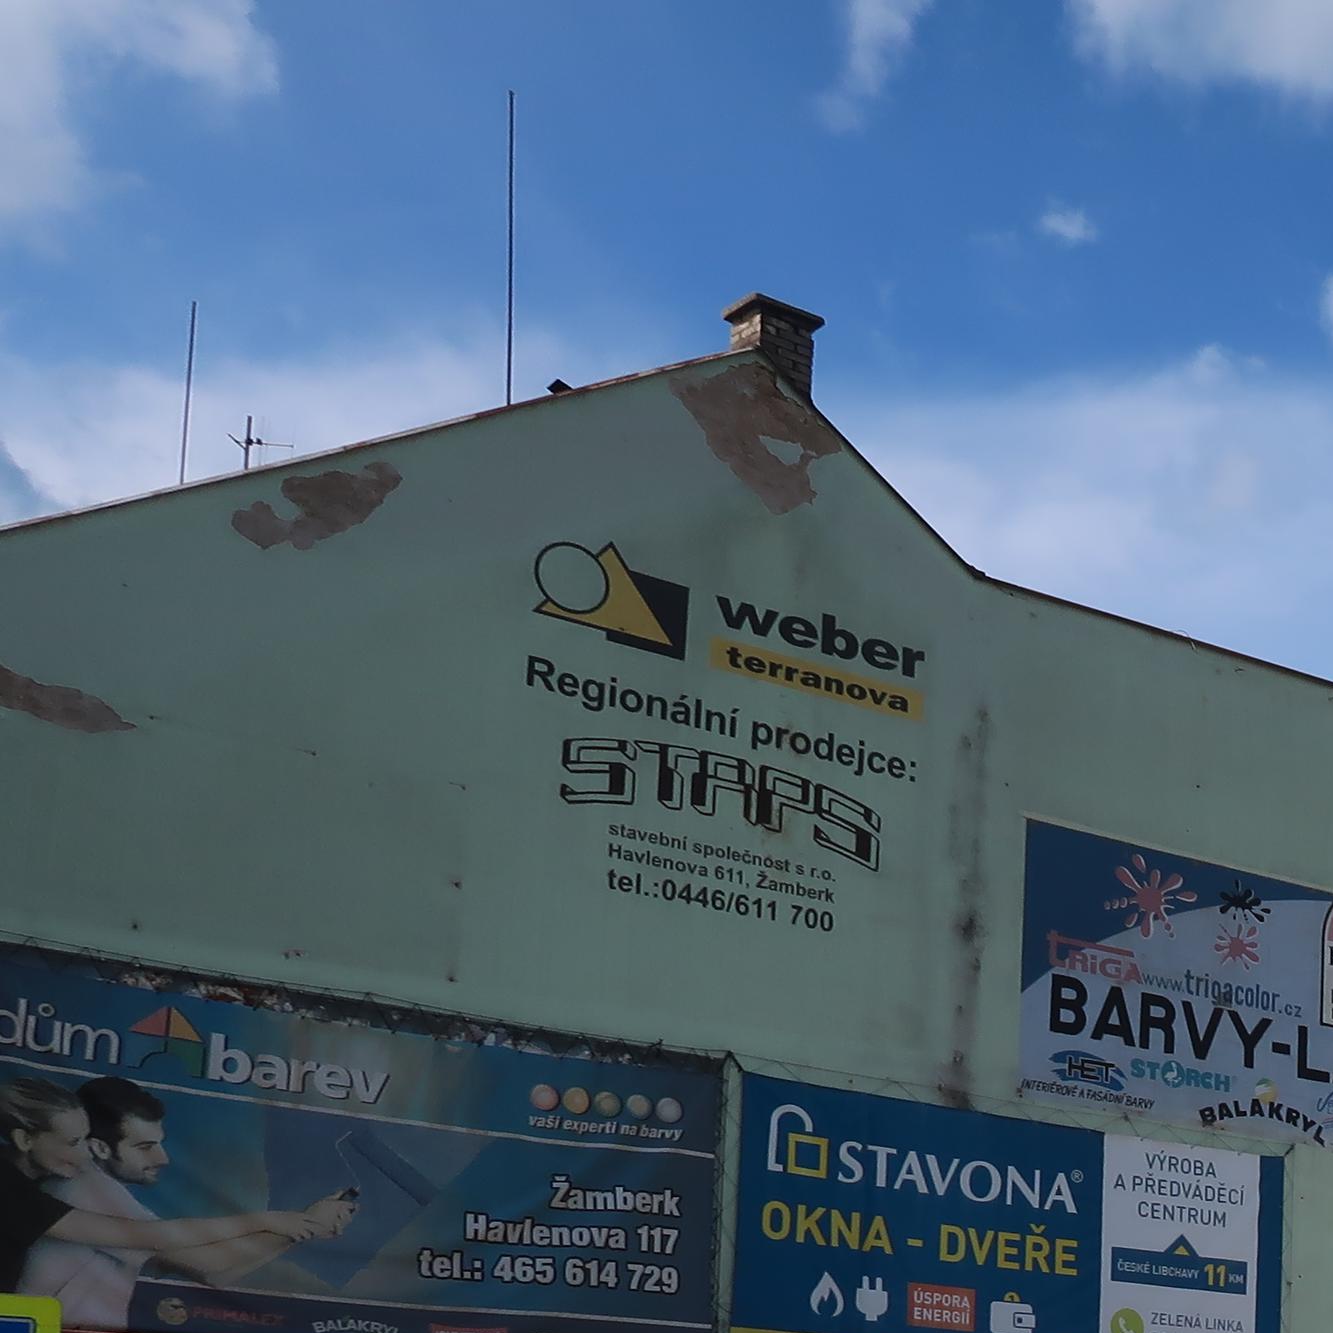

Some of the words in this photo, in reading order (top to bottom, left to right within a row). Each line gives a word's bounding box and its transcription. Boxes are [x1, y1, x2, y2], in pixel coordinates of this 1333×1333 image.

[715, 595, 926, 679] weber
[725, 645, 911, 714] terranova
[525, 655, 740, 738] Regionální
[750, 717, 918, 783] prodejce:
[560, 737, 881, 873] STAPS
[608, 823, 688, 852] stavební
[693, 839, 790, 876] společnost
[810, 863, 837, 882] r.o.
[608, 844, 708, 878] Havlenova
[715, 865, 750, 889] 611,
[755, 871, 836, 904] Žamberk
[790, 904, 834, 932] 700
[1141, 968, 1303, 1019] www.trigacolor.cz
[206, 1033, 391, 1104] barev
[1066, 1056, 1115, 1083] HET
[1021, 1078, 1078, 1097] INTERIÉROVÉ
[1125, 1096, 1155, 1110] BARVY
[529, 1113, 559, 1131] vaši
[563, 1117, 616, 1138] experti
[620, 1123, 636, 1137] na
[638, 1123, 682, 1142] barvy
[1144, 1150, 1216, 1179] VÝROBA
[549, 1174, 681, 1217] Žamberk
[1113, 1174, 1127, 1191] A
[1131, 1173, 1246, 1208] PŘEDVÁDĚCÍ
[464, 1211, 628, 1252] Havlenova
[636, 1226, 679, 1255] 117
[1137, 1199, 1228, 1228] CENTRUM
[762, 1200, 893, 1256] OKNA
[939, 1222, 1079, 1276] DVEŘE
[417, 1248, 484, 1282] tel.:
[494, 1255, 554, 1287] 465
[563, 1259, 617, 1290] 614
[627, 1264, 679, 1294] 729
[1117, 1257, 1149, 1275] ČESKÉ
[1151, 1264, 1199, 1281] LIBCHAVY
[1203, 1264, 1227, 1288] 11
[1228, 1272, 1245, 1286] KM
[913, 1286, 971, 1310] ÚSPORA
[913, 1304, 971, 1325] ENERGIÍ
[1150, 1310, 1201, 1331] ZELENÁ
[1204, 1317, 1244, 1333] LINKA
